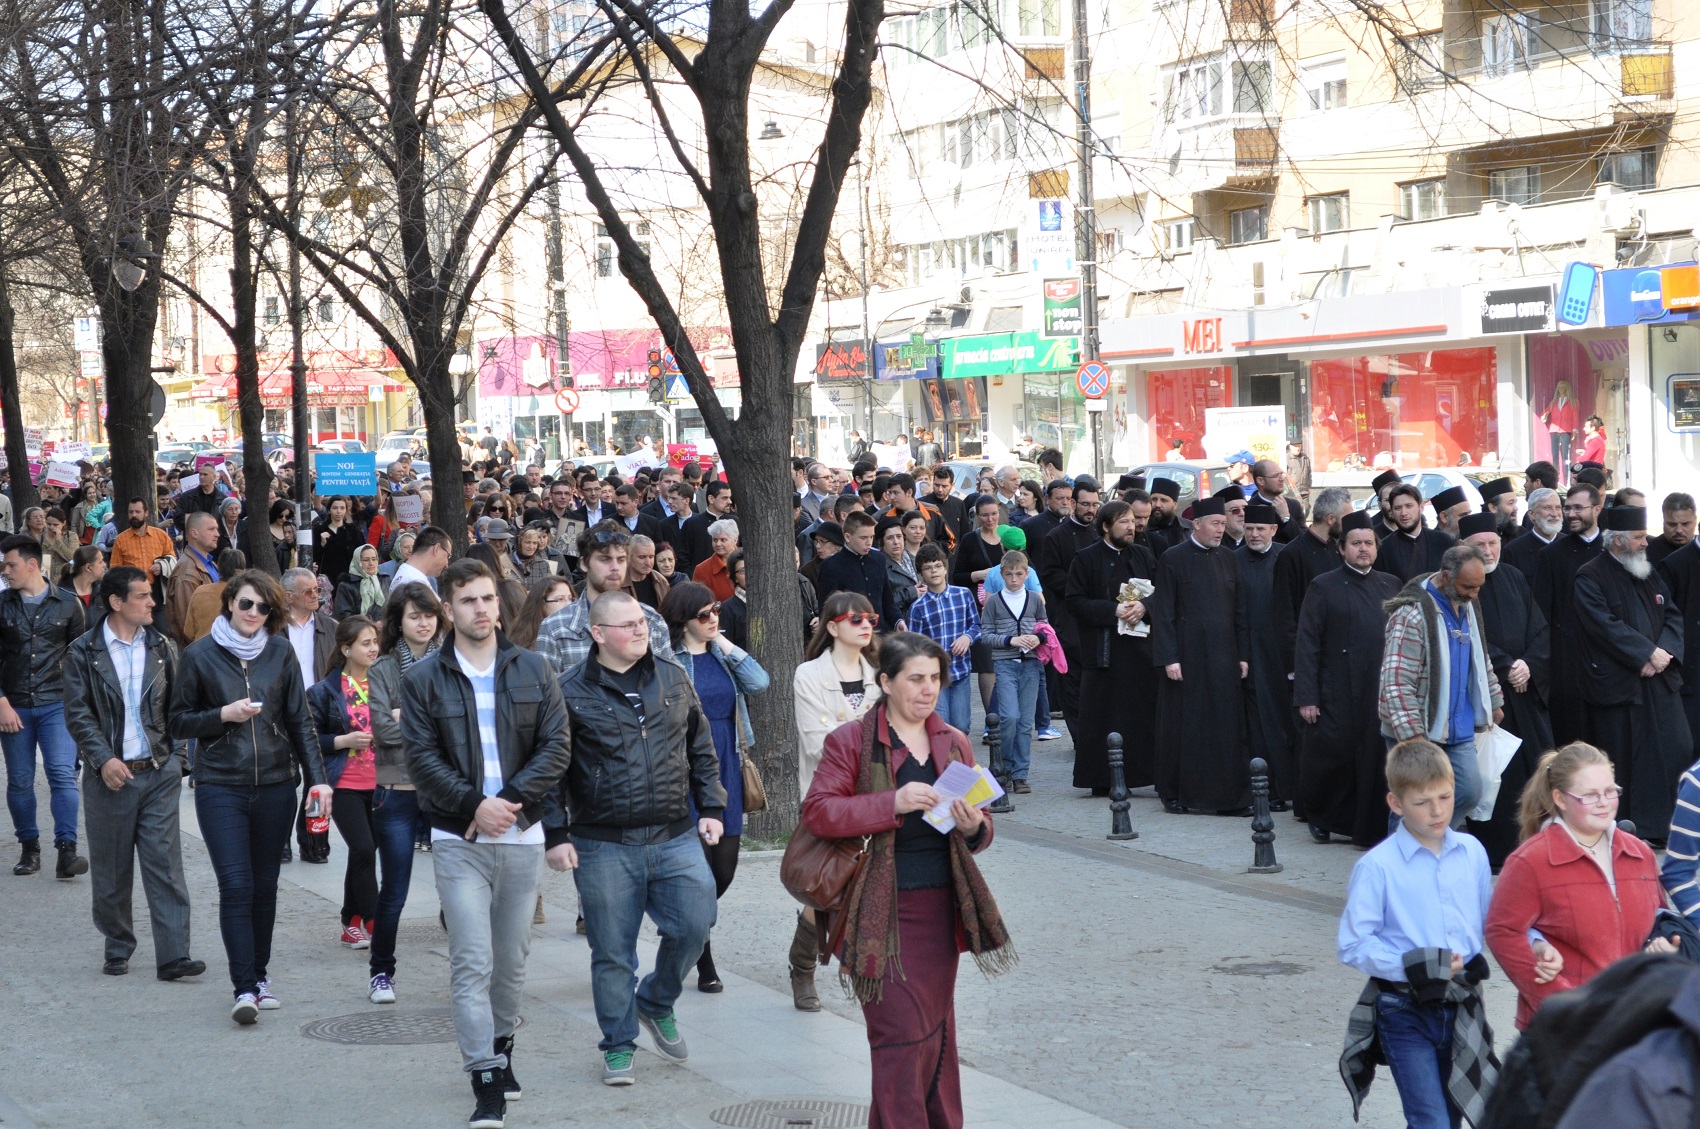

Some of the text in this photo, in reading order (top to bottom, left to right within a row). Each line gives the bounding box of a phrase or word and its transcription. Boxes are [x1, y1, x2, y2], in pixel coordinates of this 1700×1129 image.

[1031, 235, 1071, 243] HOTEL
[1030, 246, 1072, 254] UNIREA
[1052, 308, 1078, 318] non
[1518, 302, 1544, 317] OUTLET
[1053, 318, 1082, 333] stop
[1183, 318, 1223, 352] MEI
[337, 462, 354, 470] NOI
